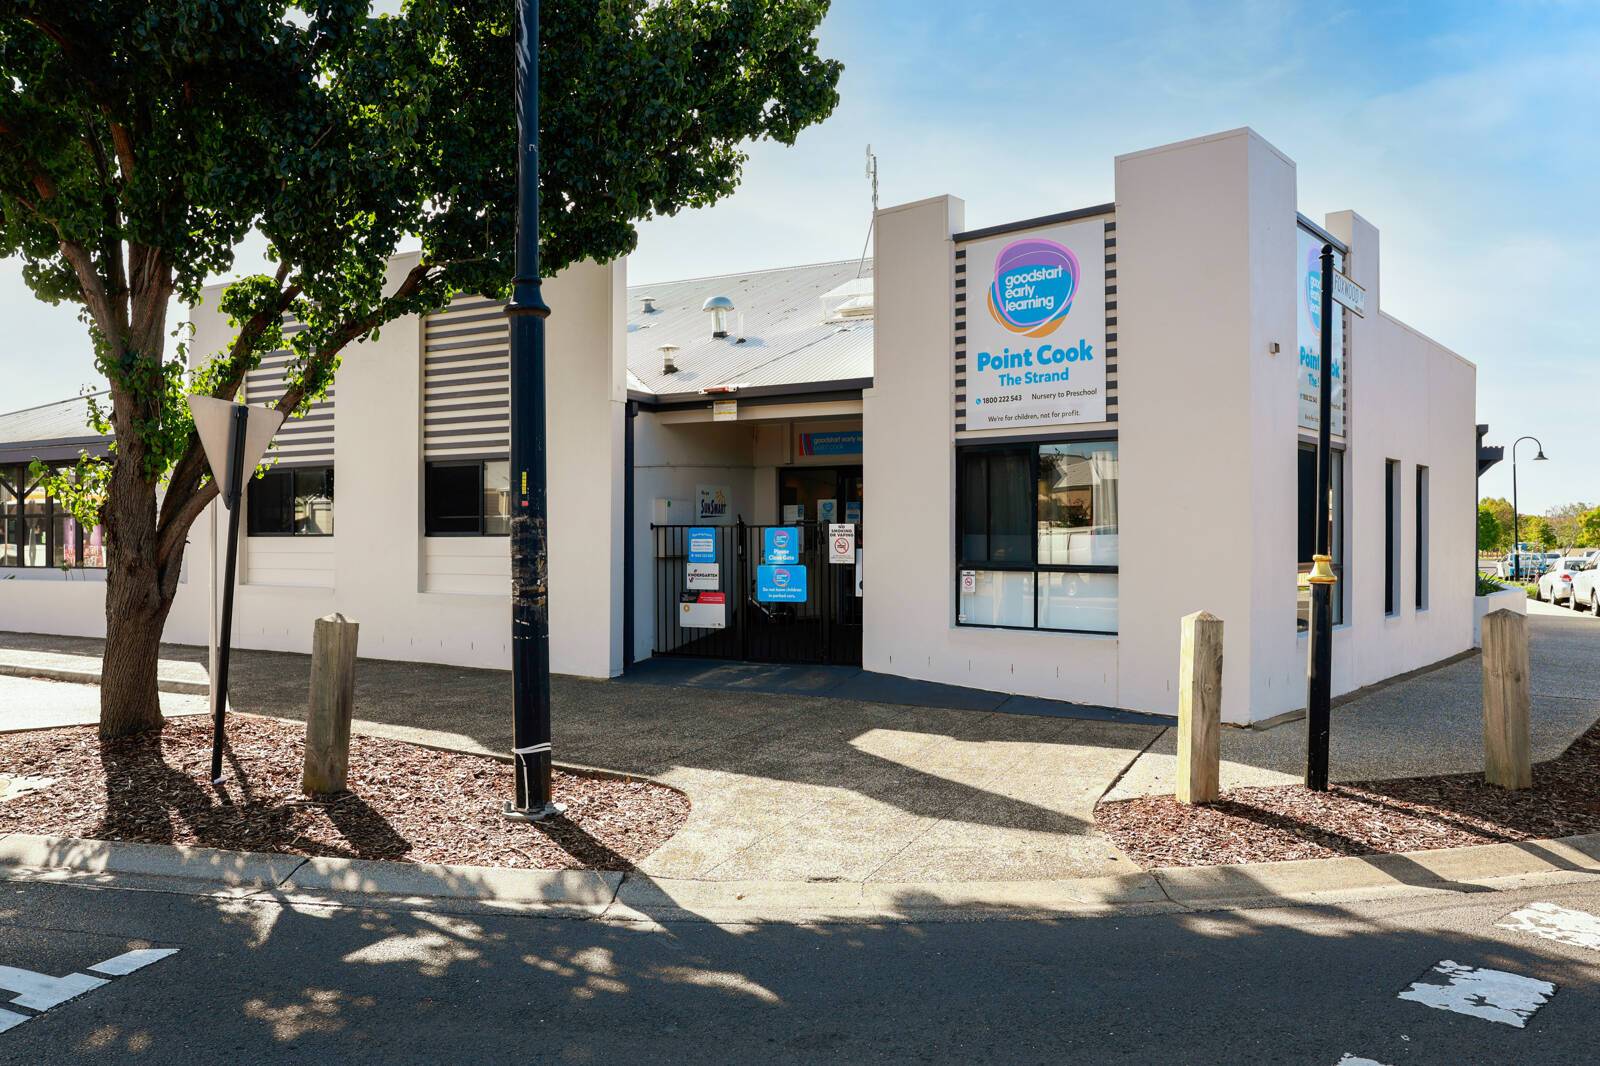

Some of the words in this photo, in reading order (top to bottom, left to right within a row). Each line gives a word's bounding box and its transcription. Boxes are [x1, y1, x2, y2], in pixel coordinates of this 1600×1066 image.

[1005, 265, 1063, 287] goodstart
[1005, 284, 1035, 299] early
[1334, 275, 1359, 303] FOXWOOD
[1005, 295, 1054, 312] learning
[977, 348, 1033, 372] Point
[1037, 339, 1093, 365] Cook
[999, 372, 1021, 387] The
[1025, 367, 1069, 385] Strand
[1031, 393, 1056, 401] Nursery
[1066, 388, 1097, 397] Preschool
[1061, 410, 1080, 418] profit.
